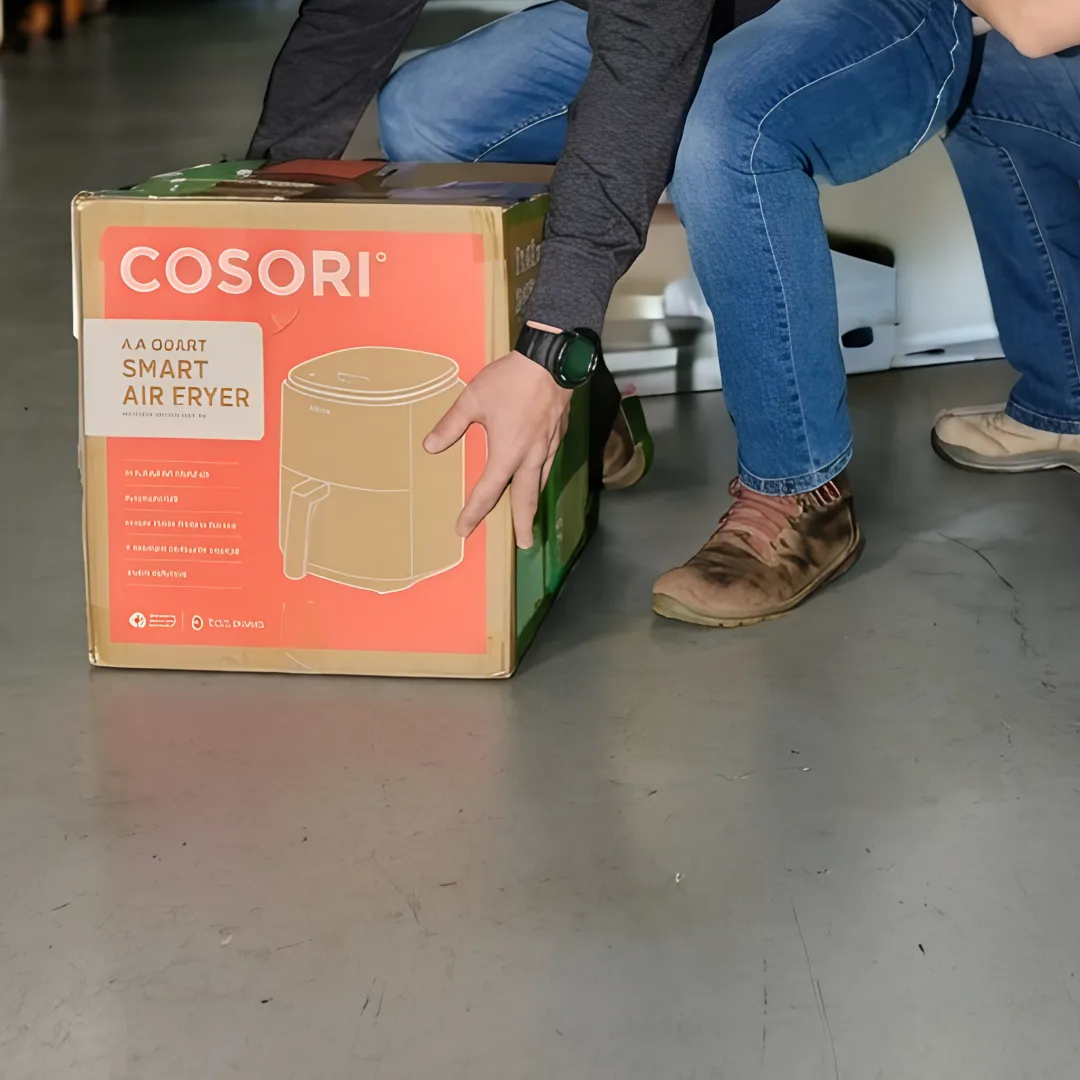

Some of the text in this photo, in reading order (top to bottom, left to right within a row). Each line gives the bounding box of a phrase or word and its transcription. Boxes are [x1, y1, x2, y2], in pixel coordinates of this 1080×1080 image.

[120, 246, 370, 297] COSORI
[122, 358, 209, 379] SMART
[122, 384, 164, 406] AIR
